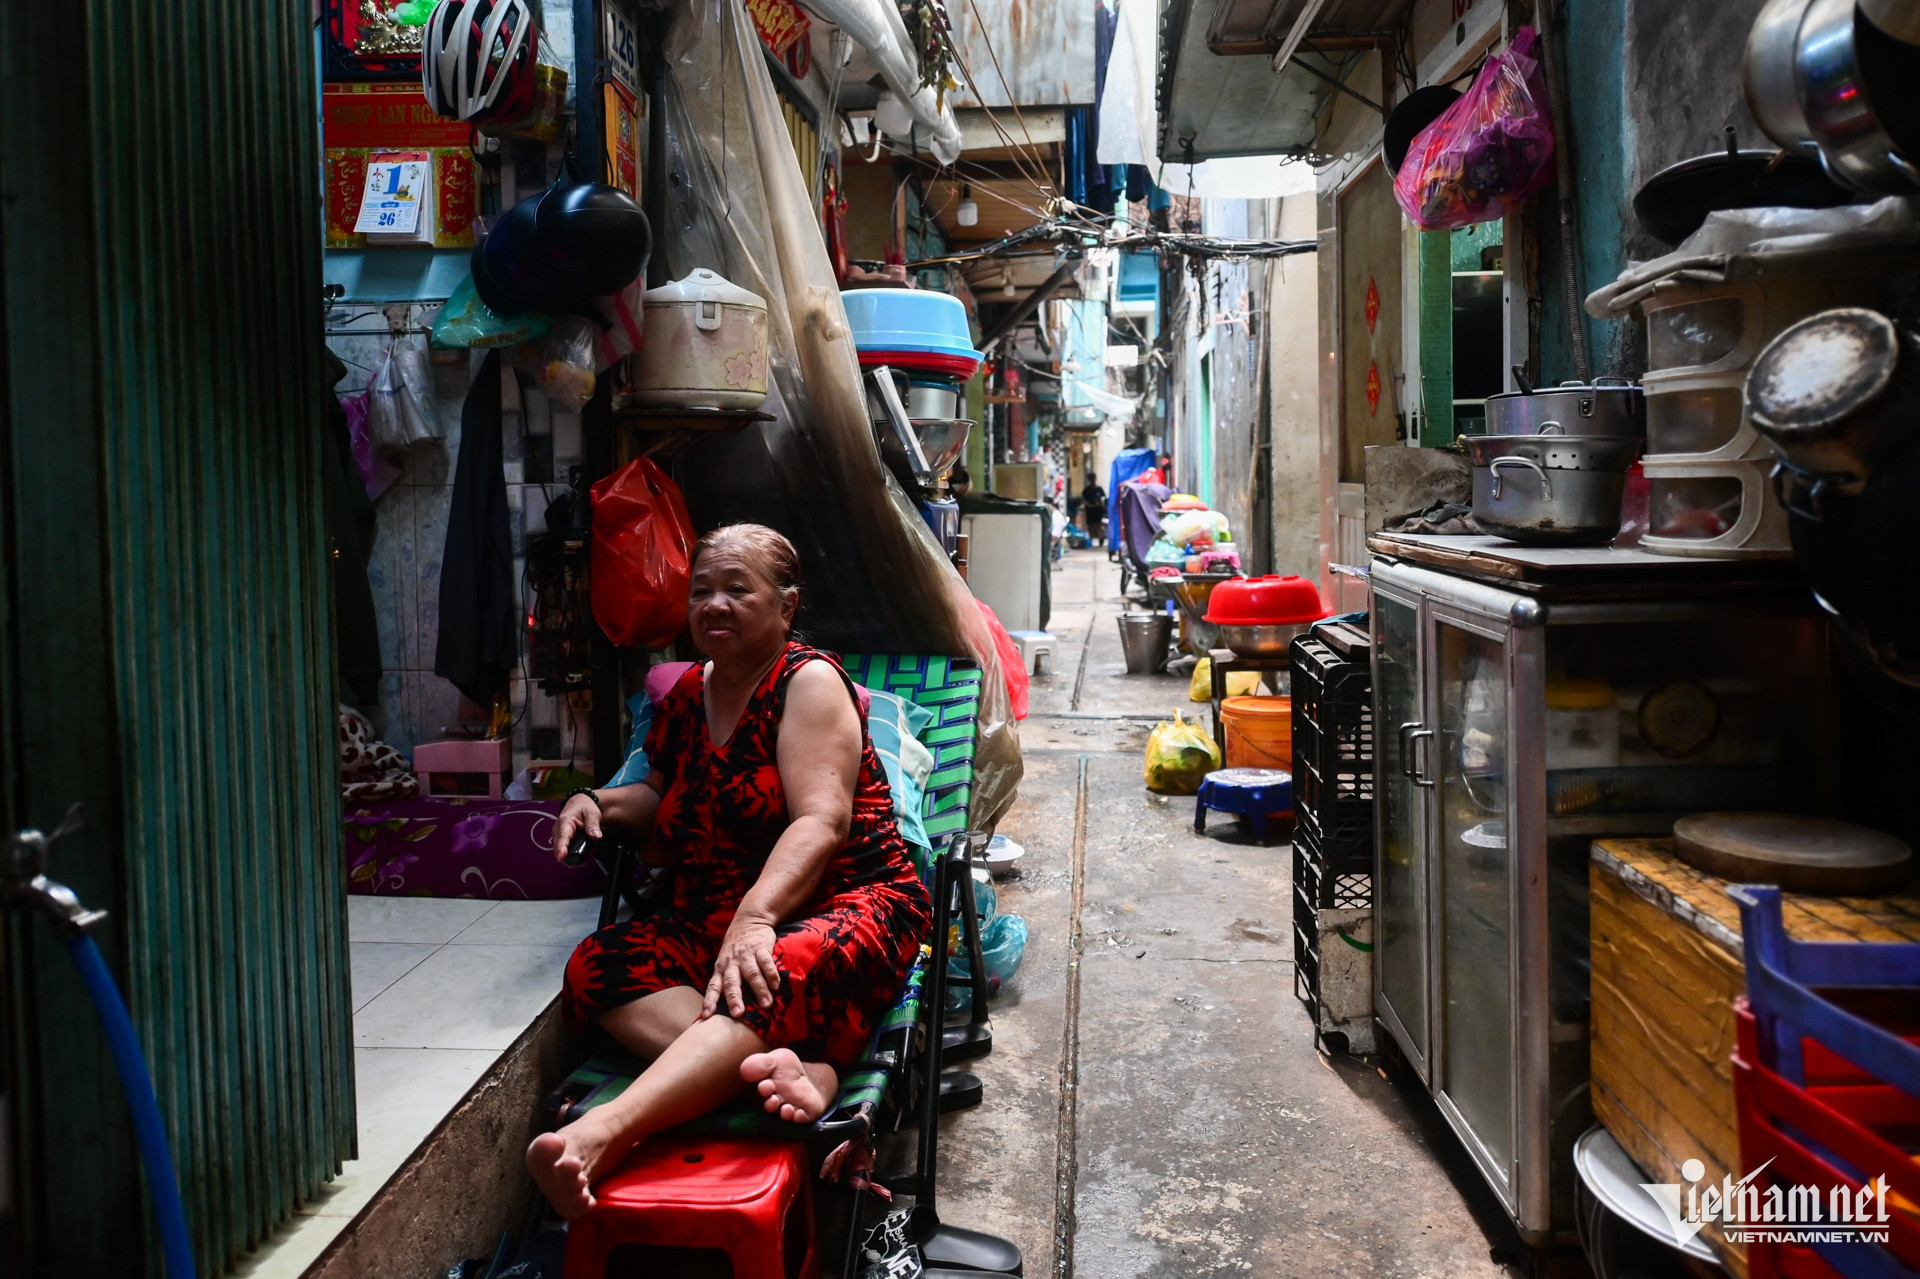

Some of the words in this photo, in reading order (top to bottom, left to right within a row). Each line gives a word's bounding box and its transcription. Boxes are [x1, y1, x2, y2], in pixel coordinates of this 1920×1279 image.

[612, 13, 634, 68] 126
[331, 104, 373, 125] SHOP
[377, 104, 406, 124] LAN
[383, 164, 401, 195] 1
[378, 212, 395, 226] 26
